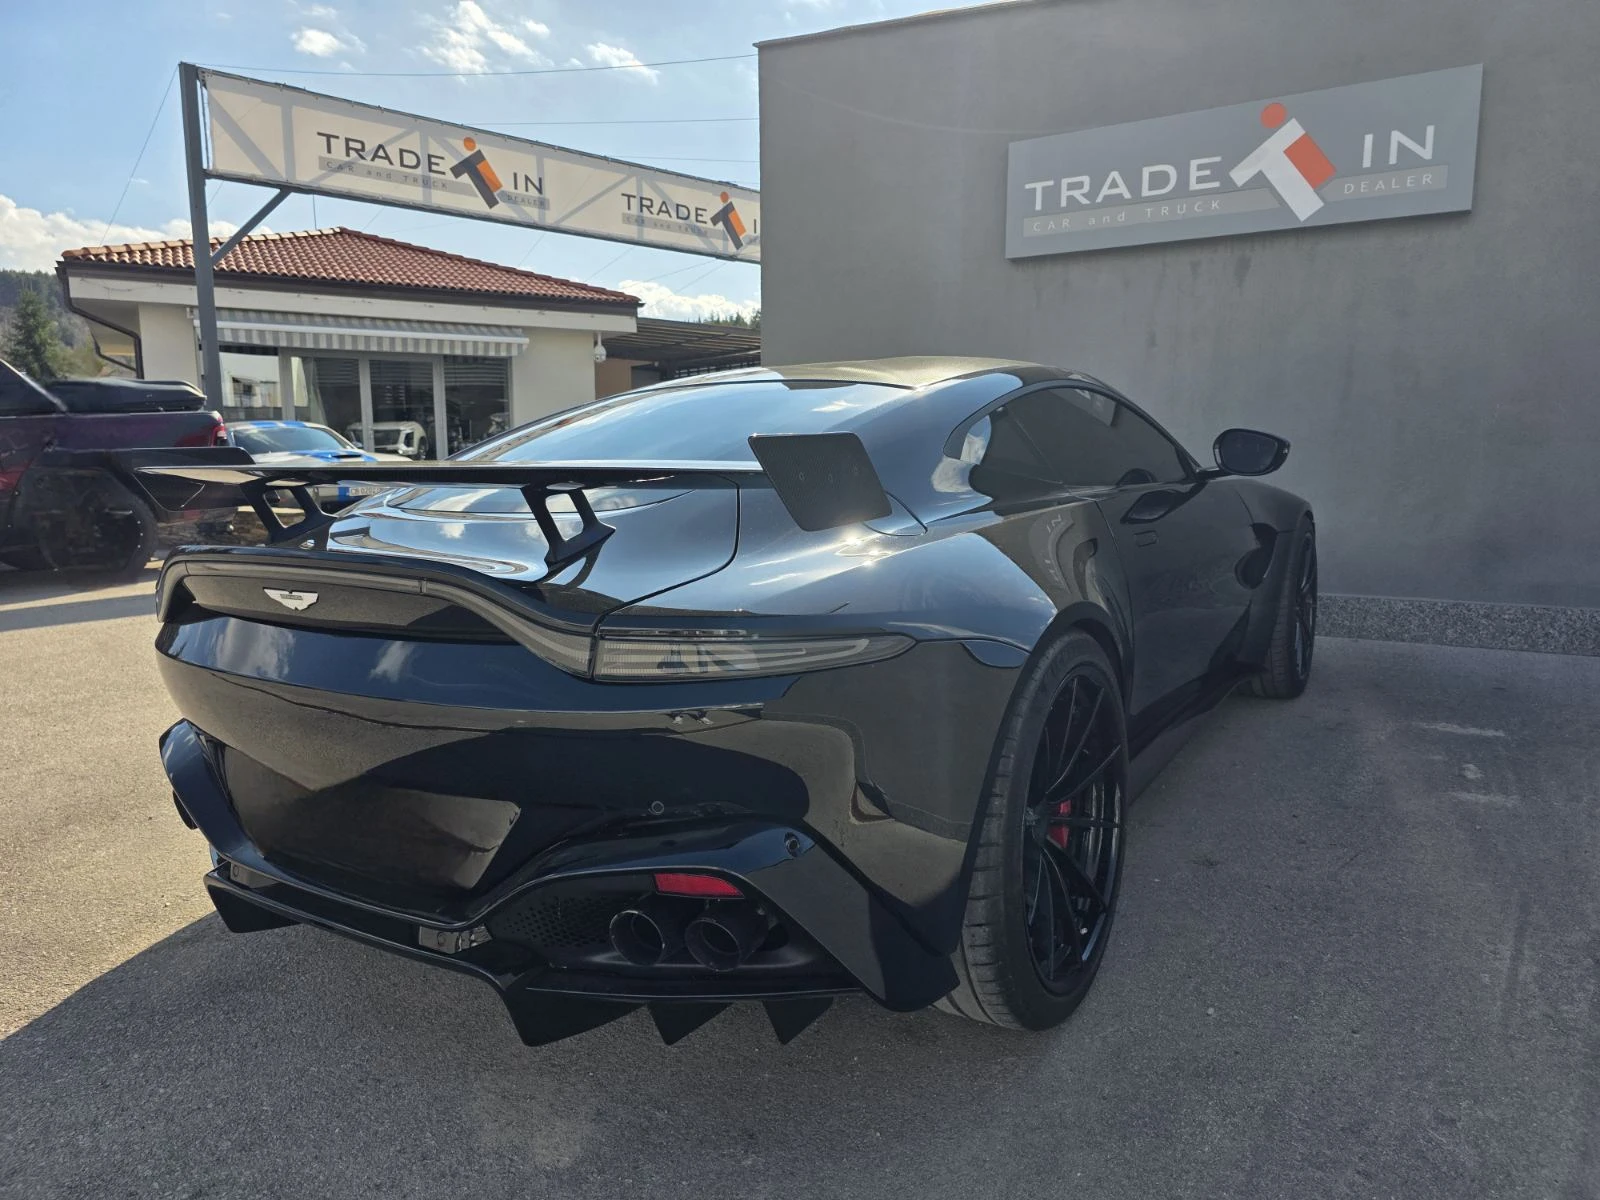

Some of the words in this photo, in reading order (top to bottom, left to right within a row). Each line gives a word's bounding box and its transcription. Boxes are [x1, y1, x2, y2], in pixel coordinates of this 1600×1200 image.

[317, 132, 446, 175] TRADE
[513, 172, 543, 195] IN
[326, 161, 354, 173] CAR
[403, 175, 448, 190] TRUCK
[1024, 156, 1222, 211] TRADE
[1362, 125, 1435, 168] IN
[621, 193, 707, 224] TRADE
[1033, 218, 1071, 232] CAR
[1089, 212, 1125, 226] and
[1145, 200, 1221, 218] TRUCK
[1344, 174, 1433, 194] DEALER
